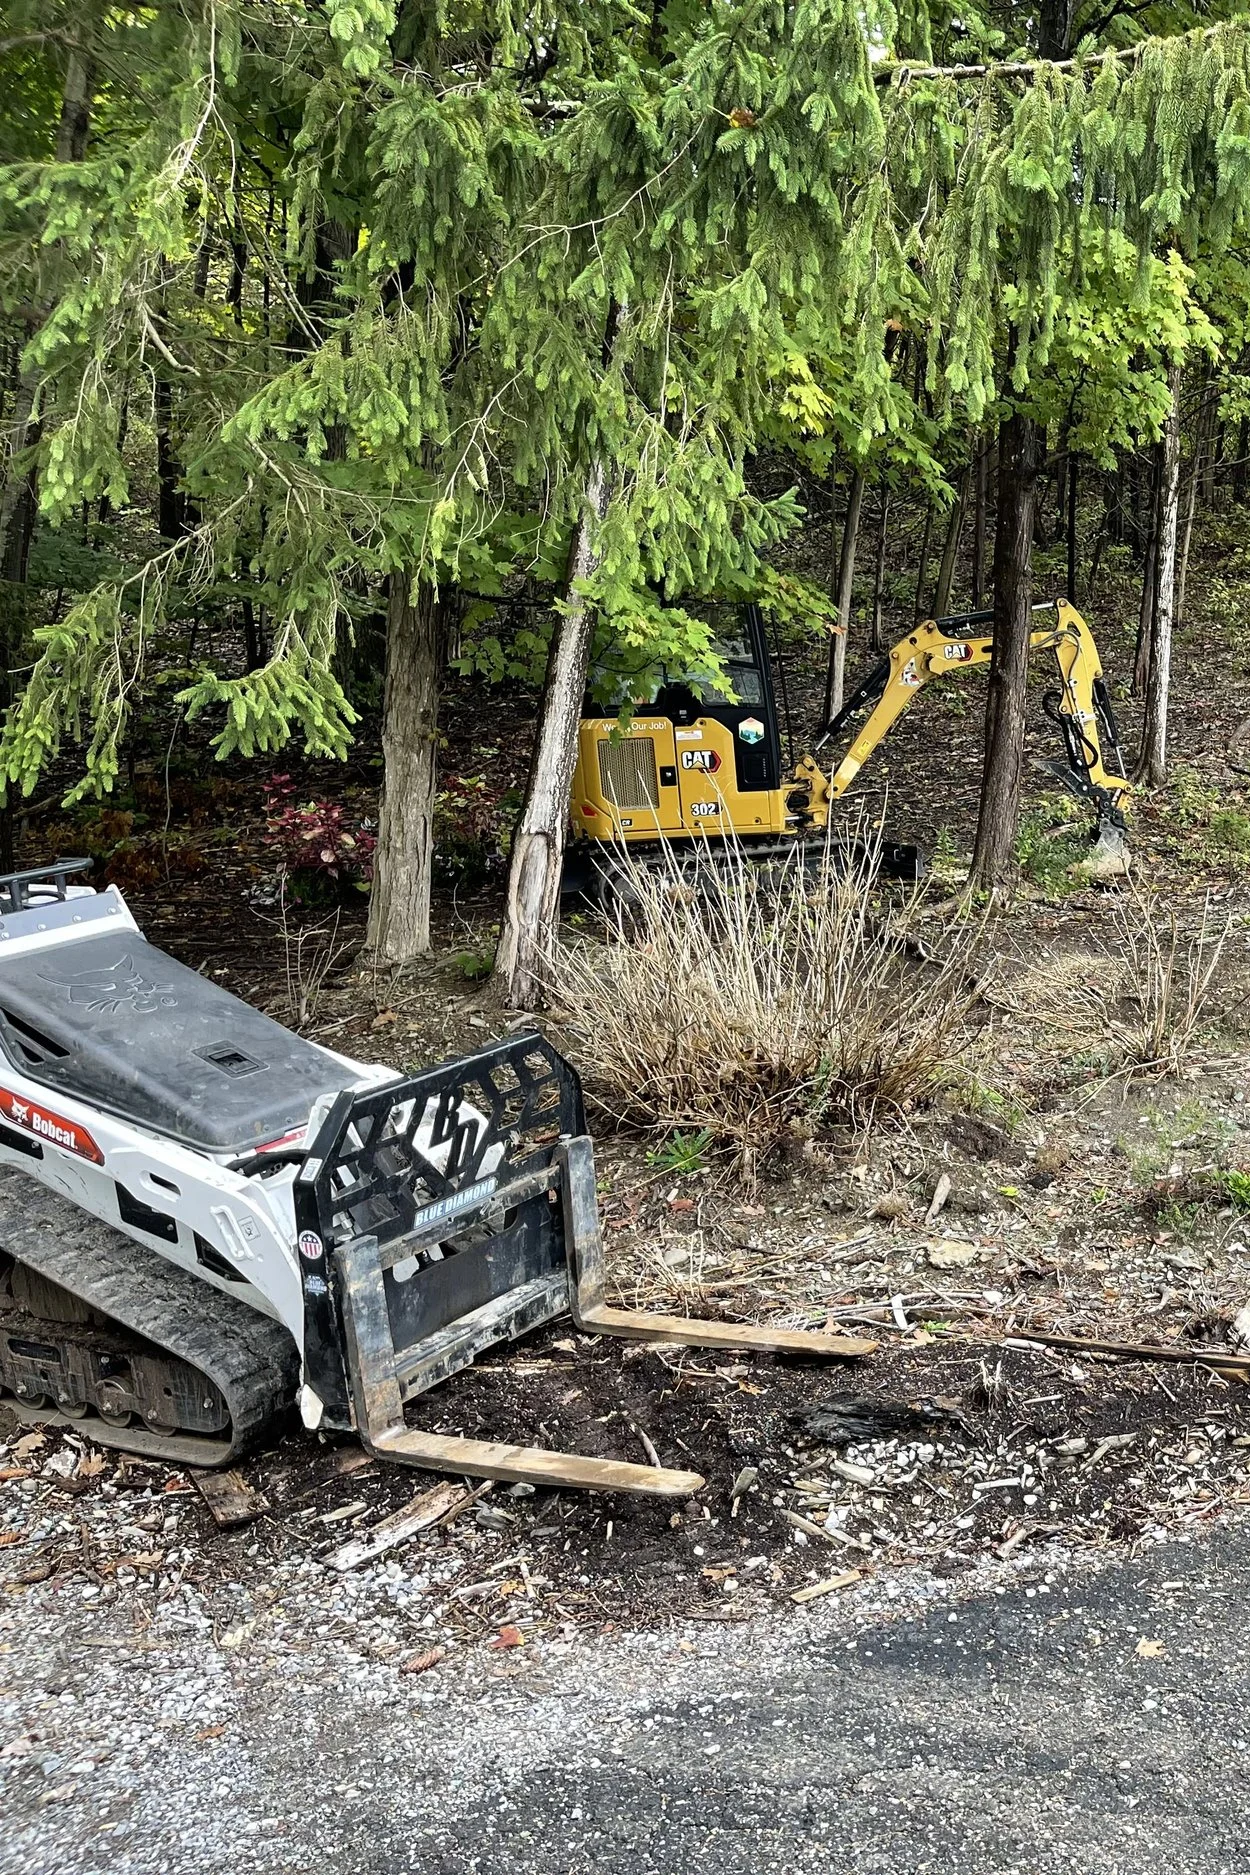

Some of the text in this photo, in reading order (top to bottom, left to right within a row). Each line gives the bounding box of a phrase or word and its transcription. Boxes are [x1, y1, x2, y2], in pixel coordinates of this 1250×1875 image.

[944, 644, 966, 659] CAT
[631, 721, 647, 730] Our
[649, 721, 667, 730] Job!
[682, 751, 711, 769] CAT
[691, 803, 716, 816] 302
[32, 1112, 76, 1149] Bobcat
[415, 1177, 497, 1228] BLUE DIAMOND
